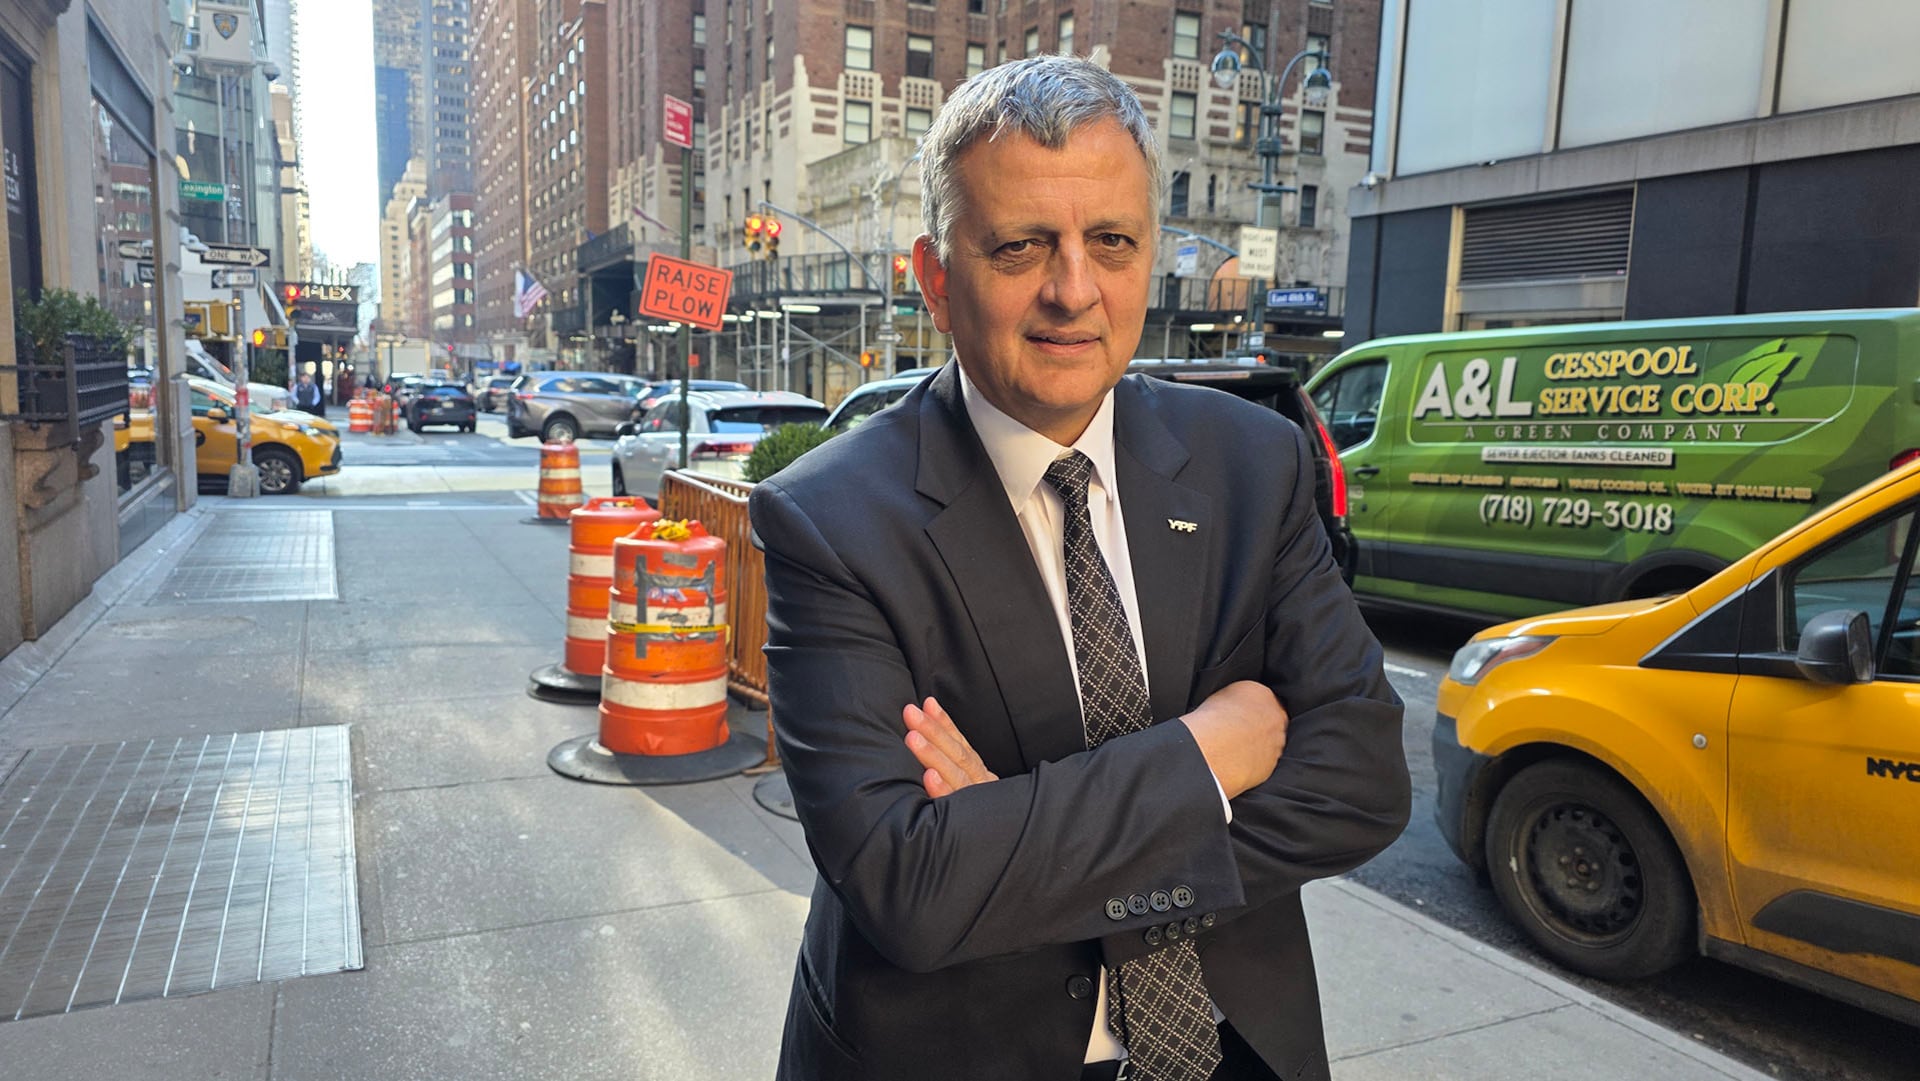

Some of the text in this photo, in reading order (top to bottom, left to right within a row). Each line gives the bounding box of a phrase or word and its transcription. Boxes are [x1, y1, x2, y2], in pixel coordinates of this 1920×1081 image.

[209, 250, 260, 261] ONE WAY
[656, 264, 721, 295] RAISE
[654, 289, 714, 319] PLOW
[1544, 346, 1698, 380] CESSPOOL
[1413, 356, 1533, 418] A&L
[1538, 382, 1776, 415] SERVICE CORP.
[1465, 423, 1746, 440] A GREEN COMPANY
[1523, 449, 1567, 460] EJECTOR
[1572, 450, 1606, 461] TANKS
[1609, 451, 1666, 463] CLEANED
[1167, 518, 1198, 533] YPF
[1480, 493, 1673, 532] (718) 729-3018
